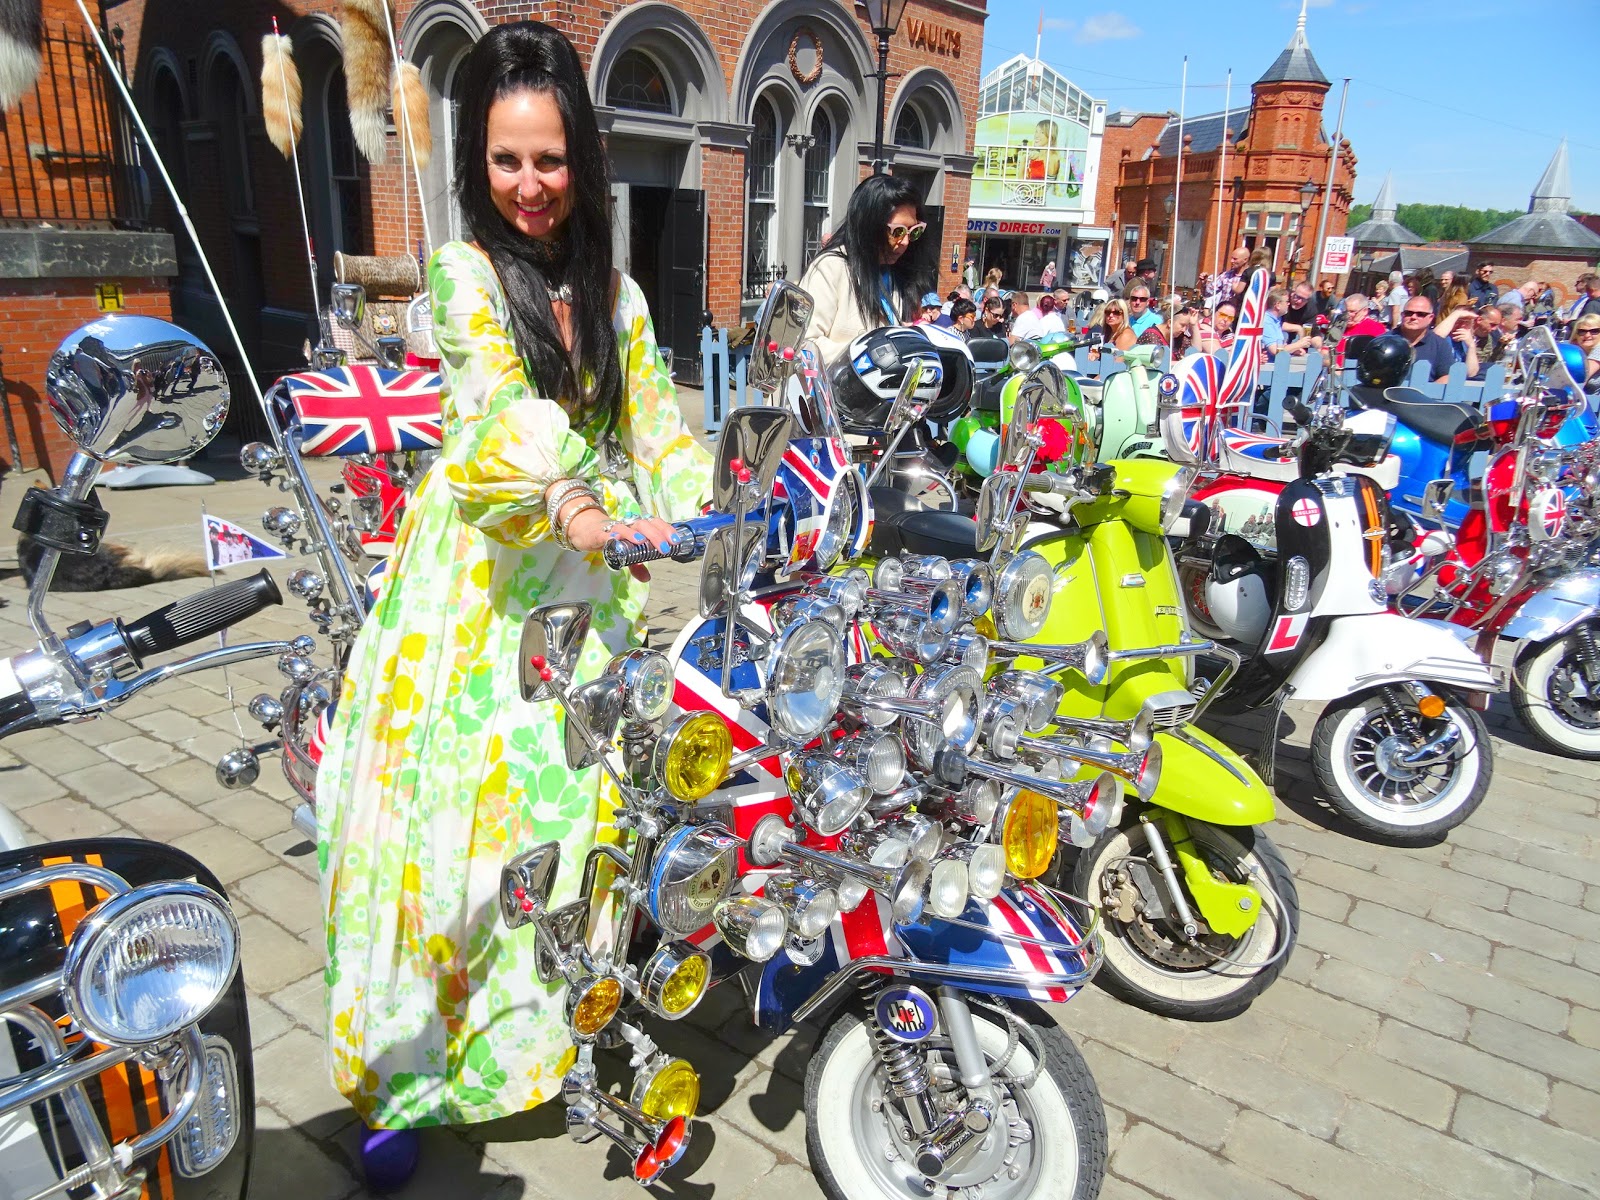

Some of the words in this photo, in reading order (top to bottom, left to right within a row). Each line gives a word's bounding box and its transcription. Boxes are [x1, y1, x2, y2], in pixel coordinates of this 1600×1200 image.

[907, 17, 961, 53] VAULTS
[1327, 243, 1337, 252] TO
[1338, 244, 1351, 252] LET
[1269, 617, 1299, 650] L
